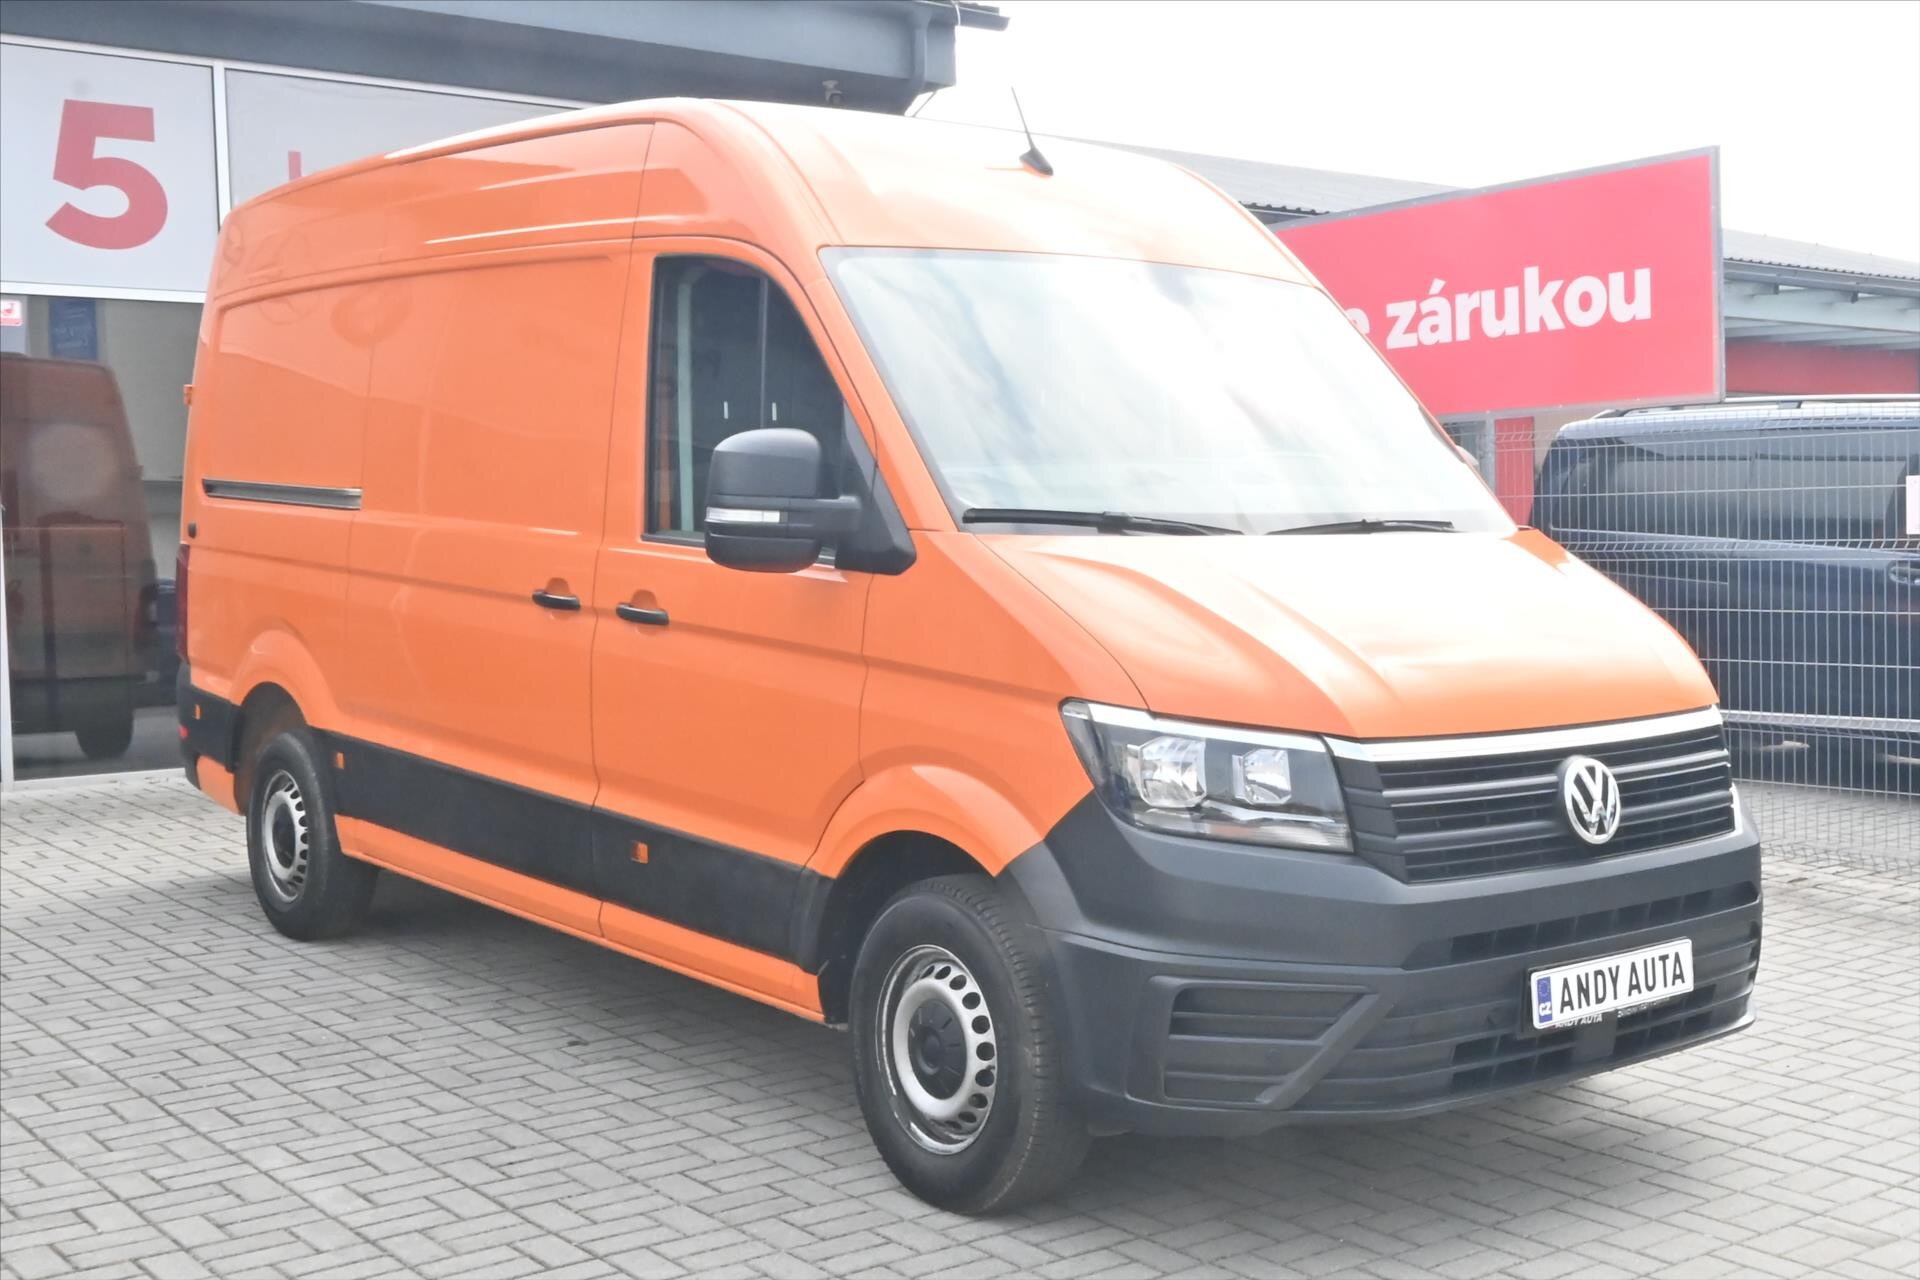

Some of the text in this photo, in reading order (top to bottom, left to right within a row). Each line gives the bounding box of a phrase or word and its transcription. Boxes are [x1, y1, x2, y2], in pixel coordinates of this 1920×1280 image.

[45, 99, 168, 250] 5
[1386, 265, 1651, 350] zárukou
[1539, 1003, 1551, 1016] CZ
[1560, 965, 1620, 1014] ANDY
[1628, 952, 1685, 997] AUTA
